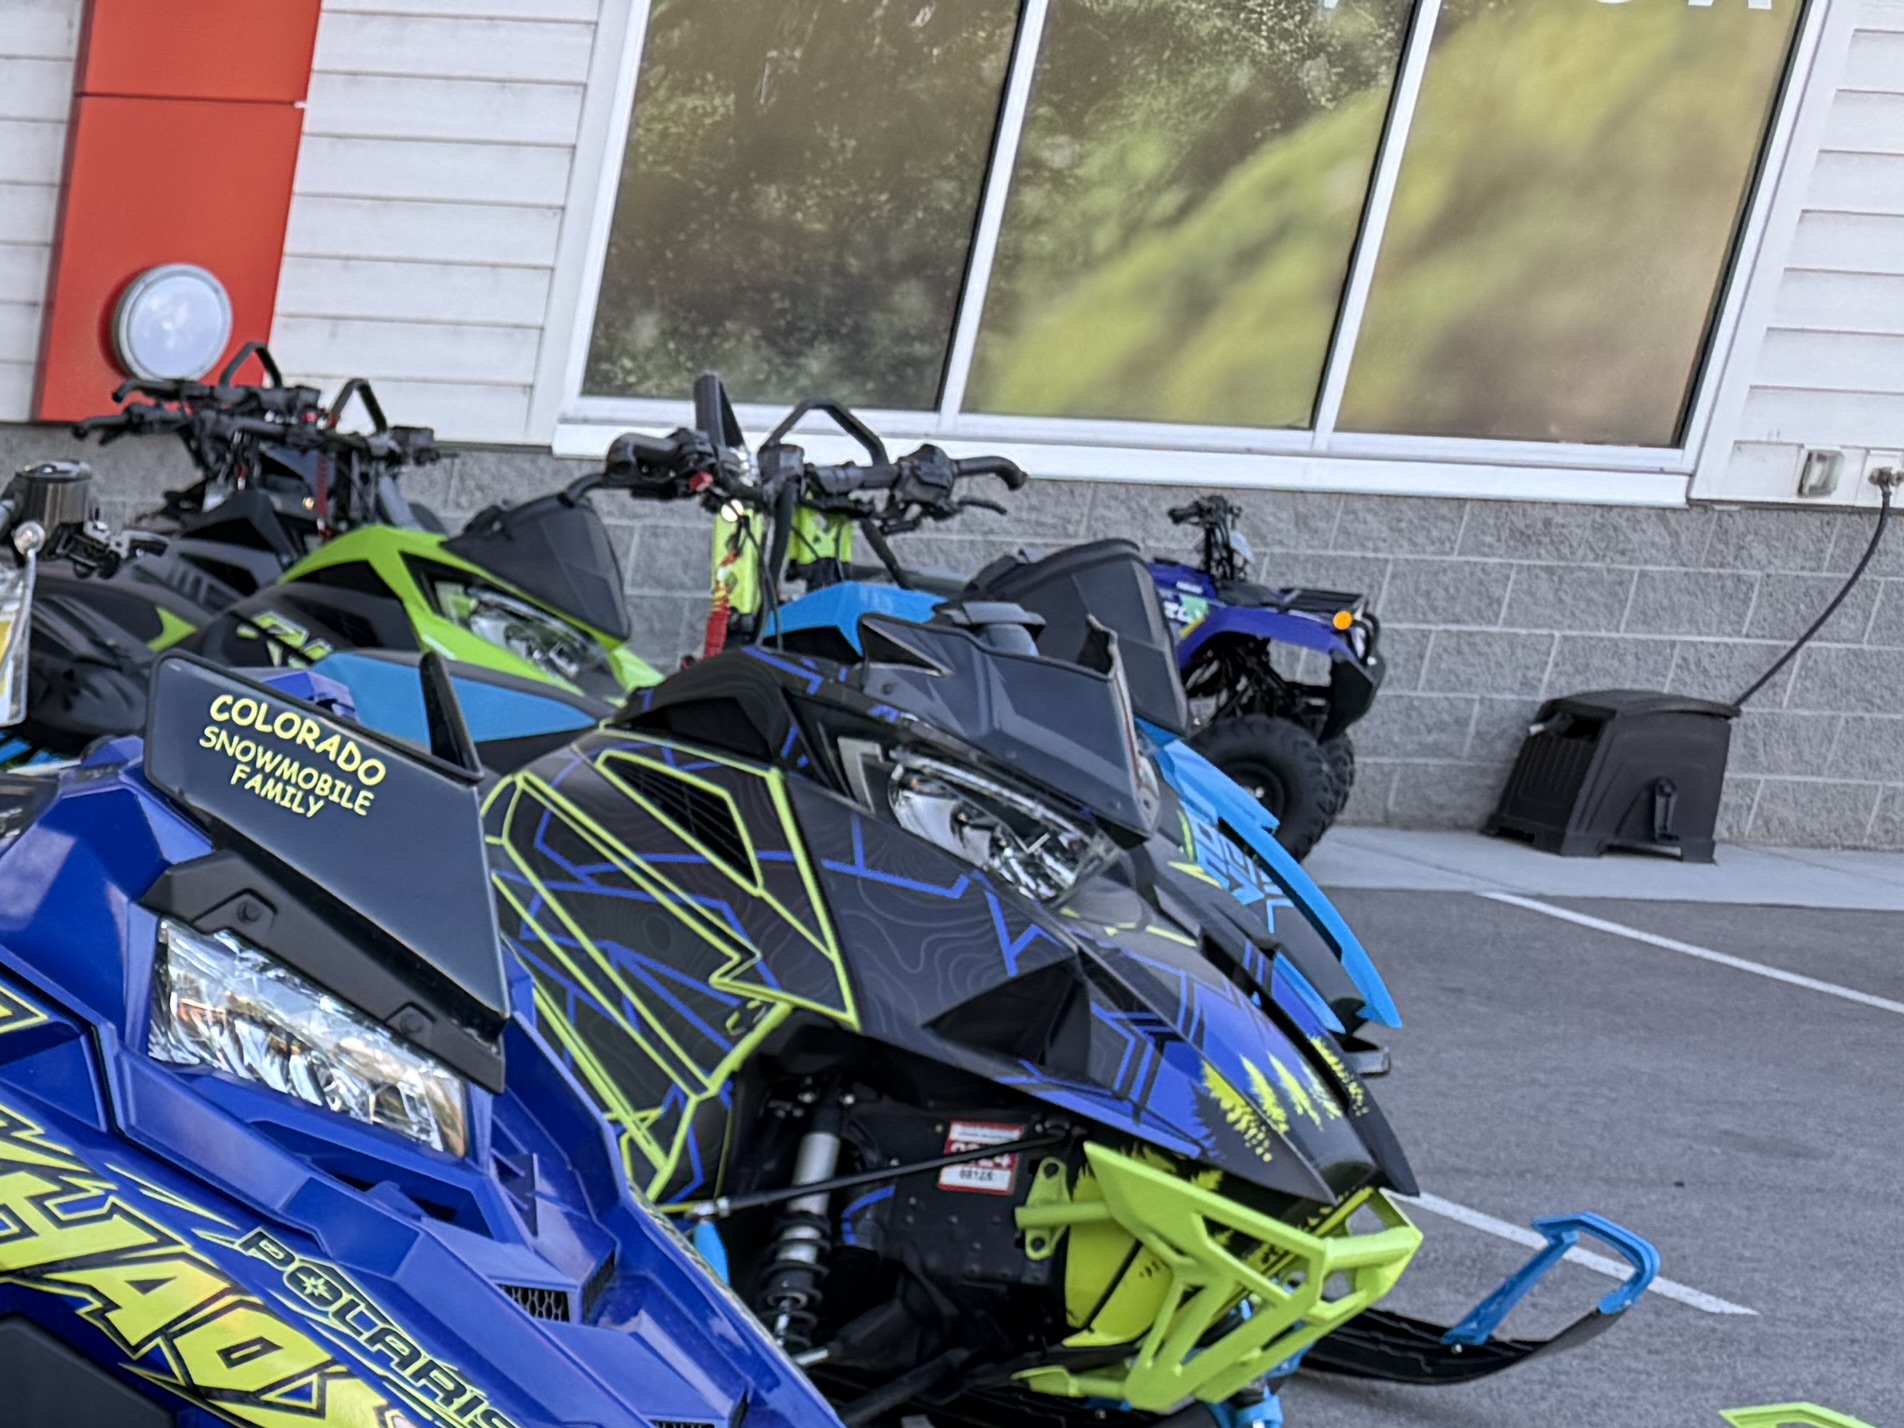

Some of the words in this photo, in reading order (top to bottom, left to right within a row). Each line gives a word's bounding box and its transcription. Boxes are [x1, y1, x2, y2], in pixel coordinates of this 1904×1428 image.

[199, 726, 375, 816] SNOWMOBILE
[210, 694, 386, 786] COLORADO
[231, 764, 324, 818] FAMILY
